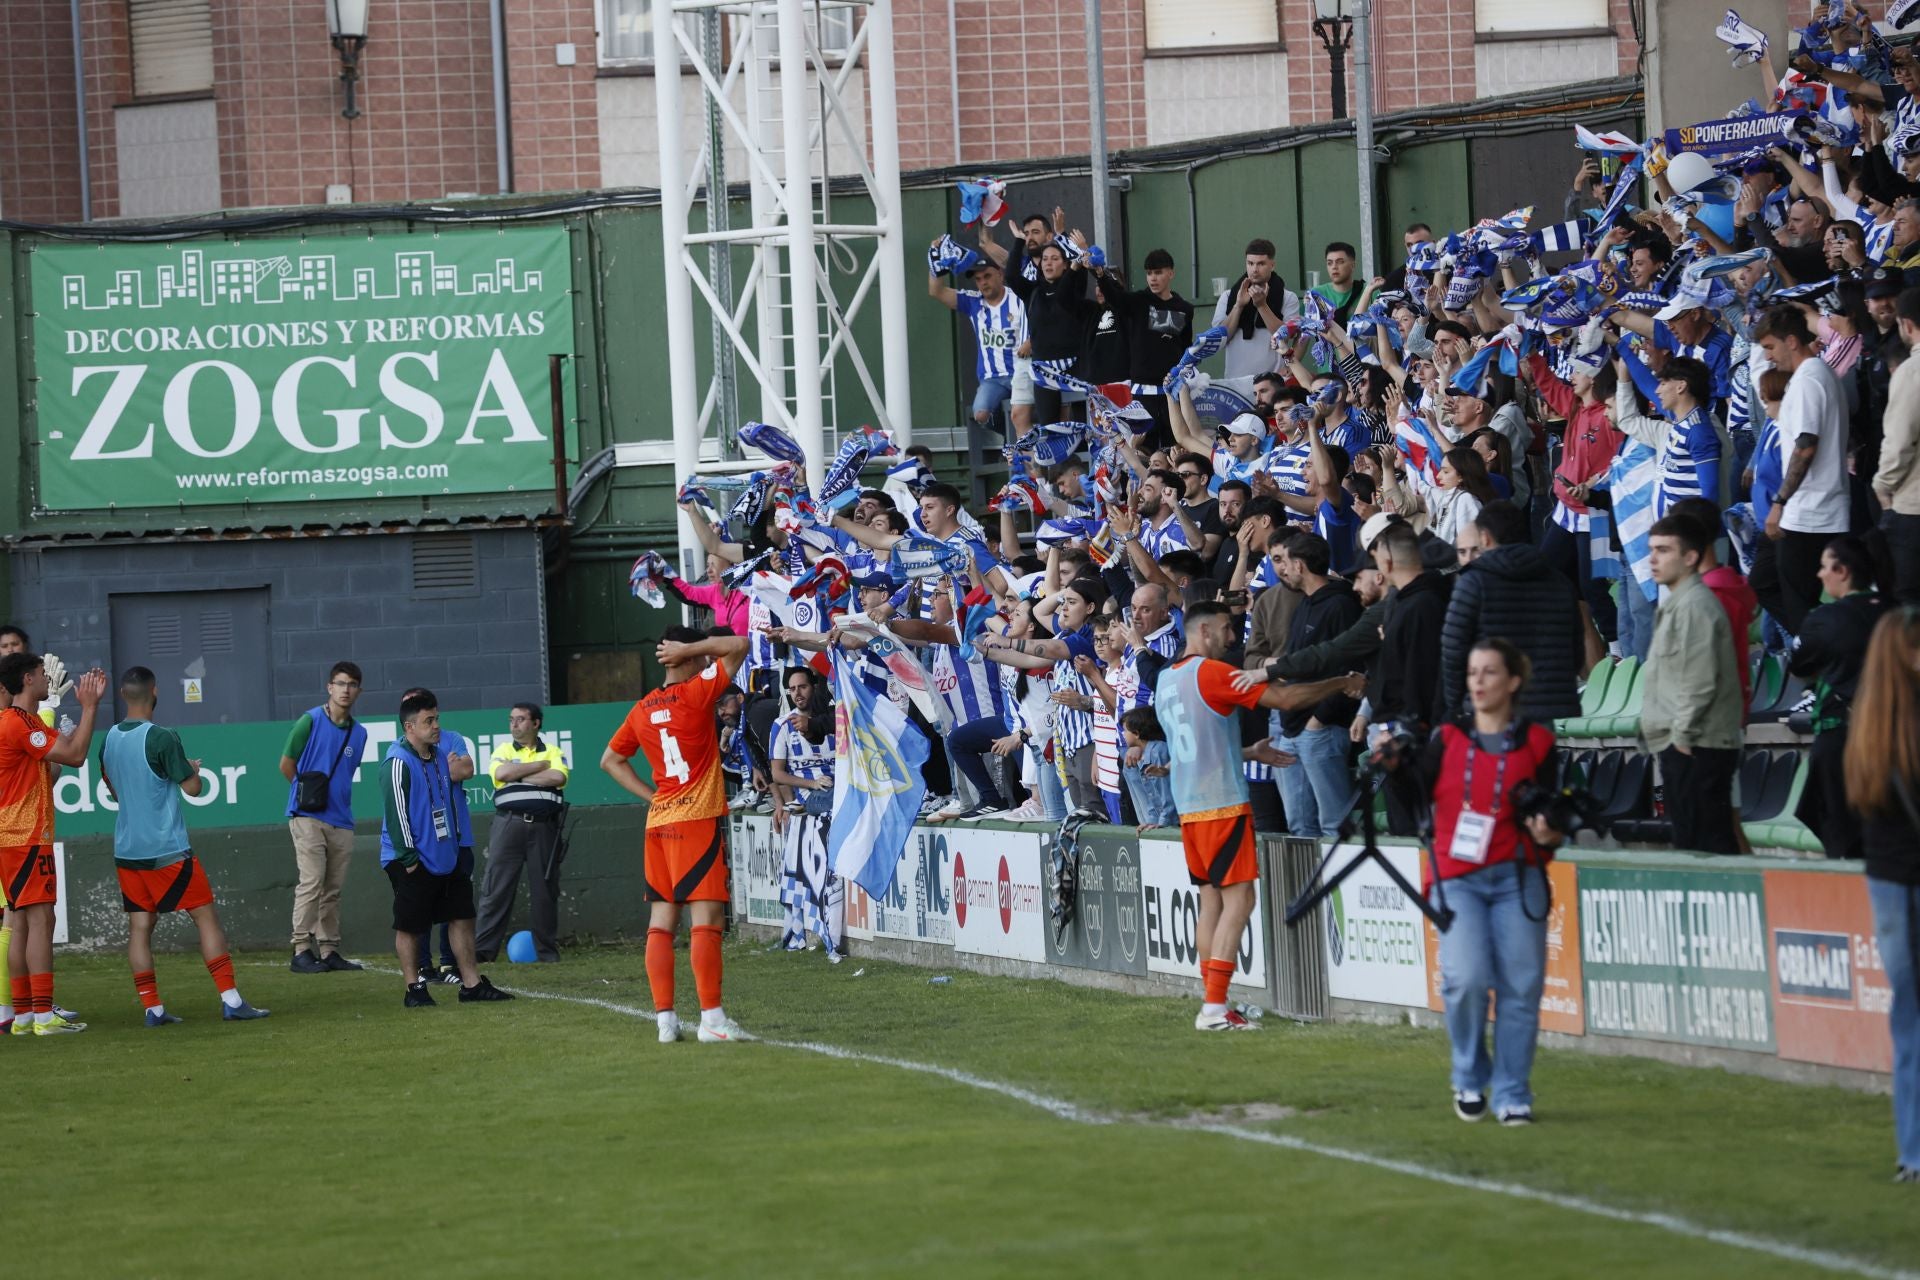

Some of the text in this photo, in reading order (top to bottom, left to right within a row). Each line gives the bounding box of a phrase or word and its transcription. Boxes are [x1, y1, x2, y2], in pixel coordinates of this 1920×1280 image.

[65, 311, 545, 354] DECORACIONES Y REFORMAS
[982, 327, 1017, 349] bio3
[70, 347, 548, 461] ZOGSA
[176, 463, 448, 489] www.reformaszogsa.com
[659, 727, 690, 785] 4
[1144, 885, 1253, 976] EL COO
[1347, 918, 1423, 966] ENERGREEN
[1581, 888, 1688, 967] RESTAURANTE
[1687, 890, 1767, 972] FERRARA
[1778, 943, 1850, 990] OBRAMAT
[1588, 979, 1621, 1030] PLAZA
[1619, 981, 1635, 1031] EL
